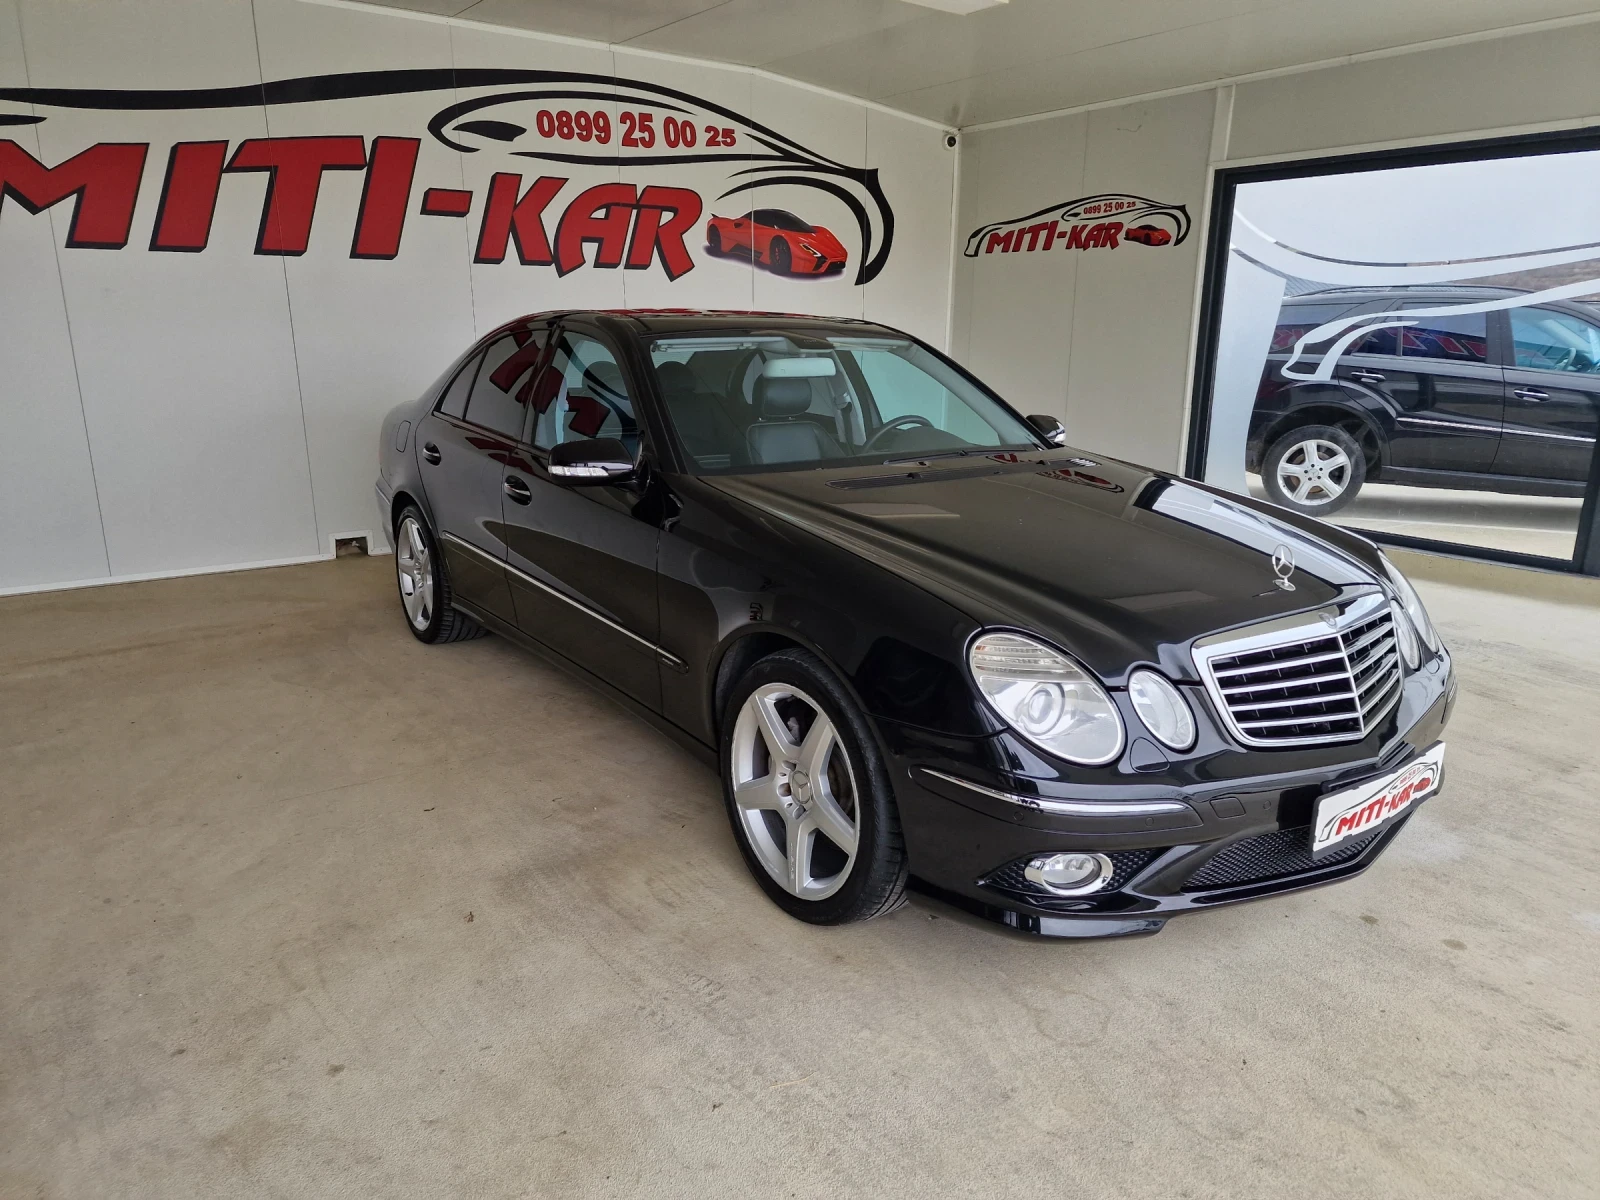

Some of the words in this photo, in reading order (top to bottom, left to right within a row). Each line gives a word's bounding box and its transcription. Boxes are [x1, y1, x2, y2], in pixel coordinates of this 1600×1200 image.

[536, 109, 611, 144] 0899
[620, 112, 655, 148] 25
[663, 116, 697, 148] 00
[705, 125, 737, 147] 25
[0, 134, 703, 282] MITI-KAR
[1083, 204, 1102, 215] 0899
[1103, 202, 1113, 213] 25
[1114, 201, 1125, 211] 00
[1126, 201, 1136, 209] 25
[985, 220, 1123, 253] MITI-KAR
[1335, 782, 1414, 835] MITI-KAR
